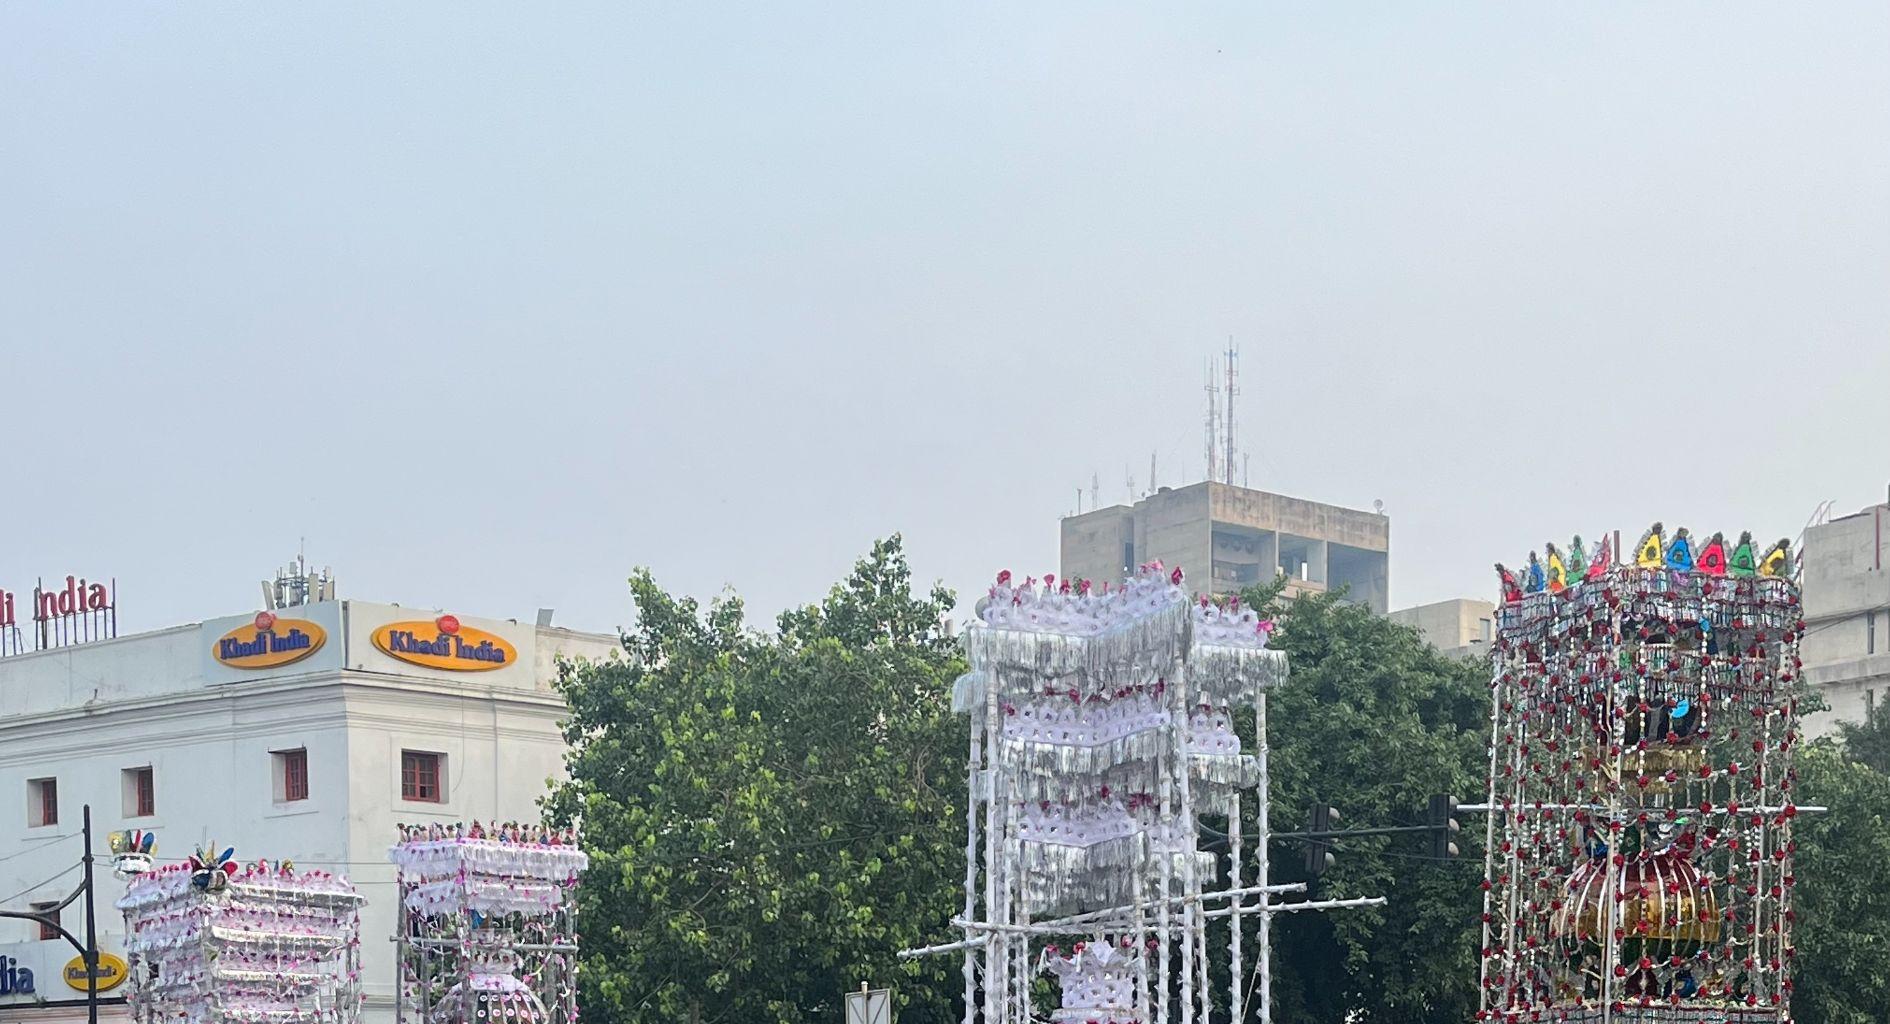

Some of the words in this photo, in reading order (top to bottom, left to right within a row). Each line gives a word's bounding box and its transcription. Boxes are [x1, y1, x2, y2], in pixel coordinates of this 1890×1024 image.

[33, 575, 107, 621] India
[220, 630, 267, 660] Khadi
[270, 629, 311, 653] India
[390, 629, 451, 656] Khadi
[455, 635, 506, 663] India
